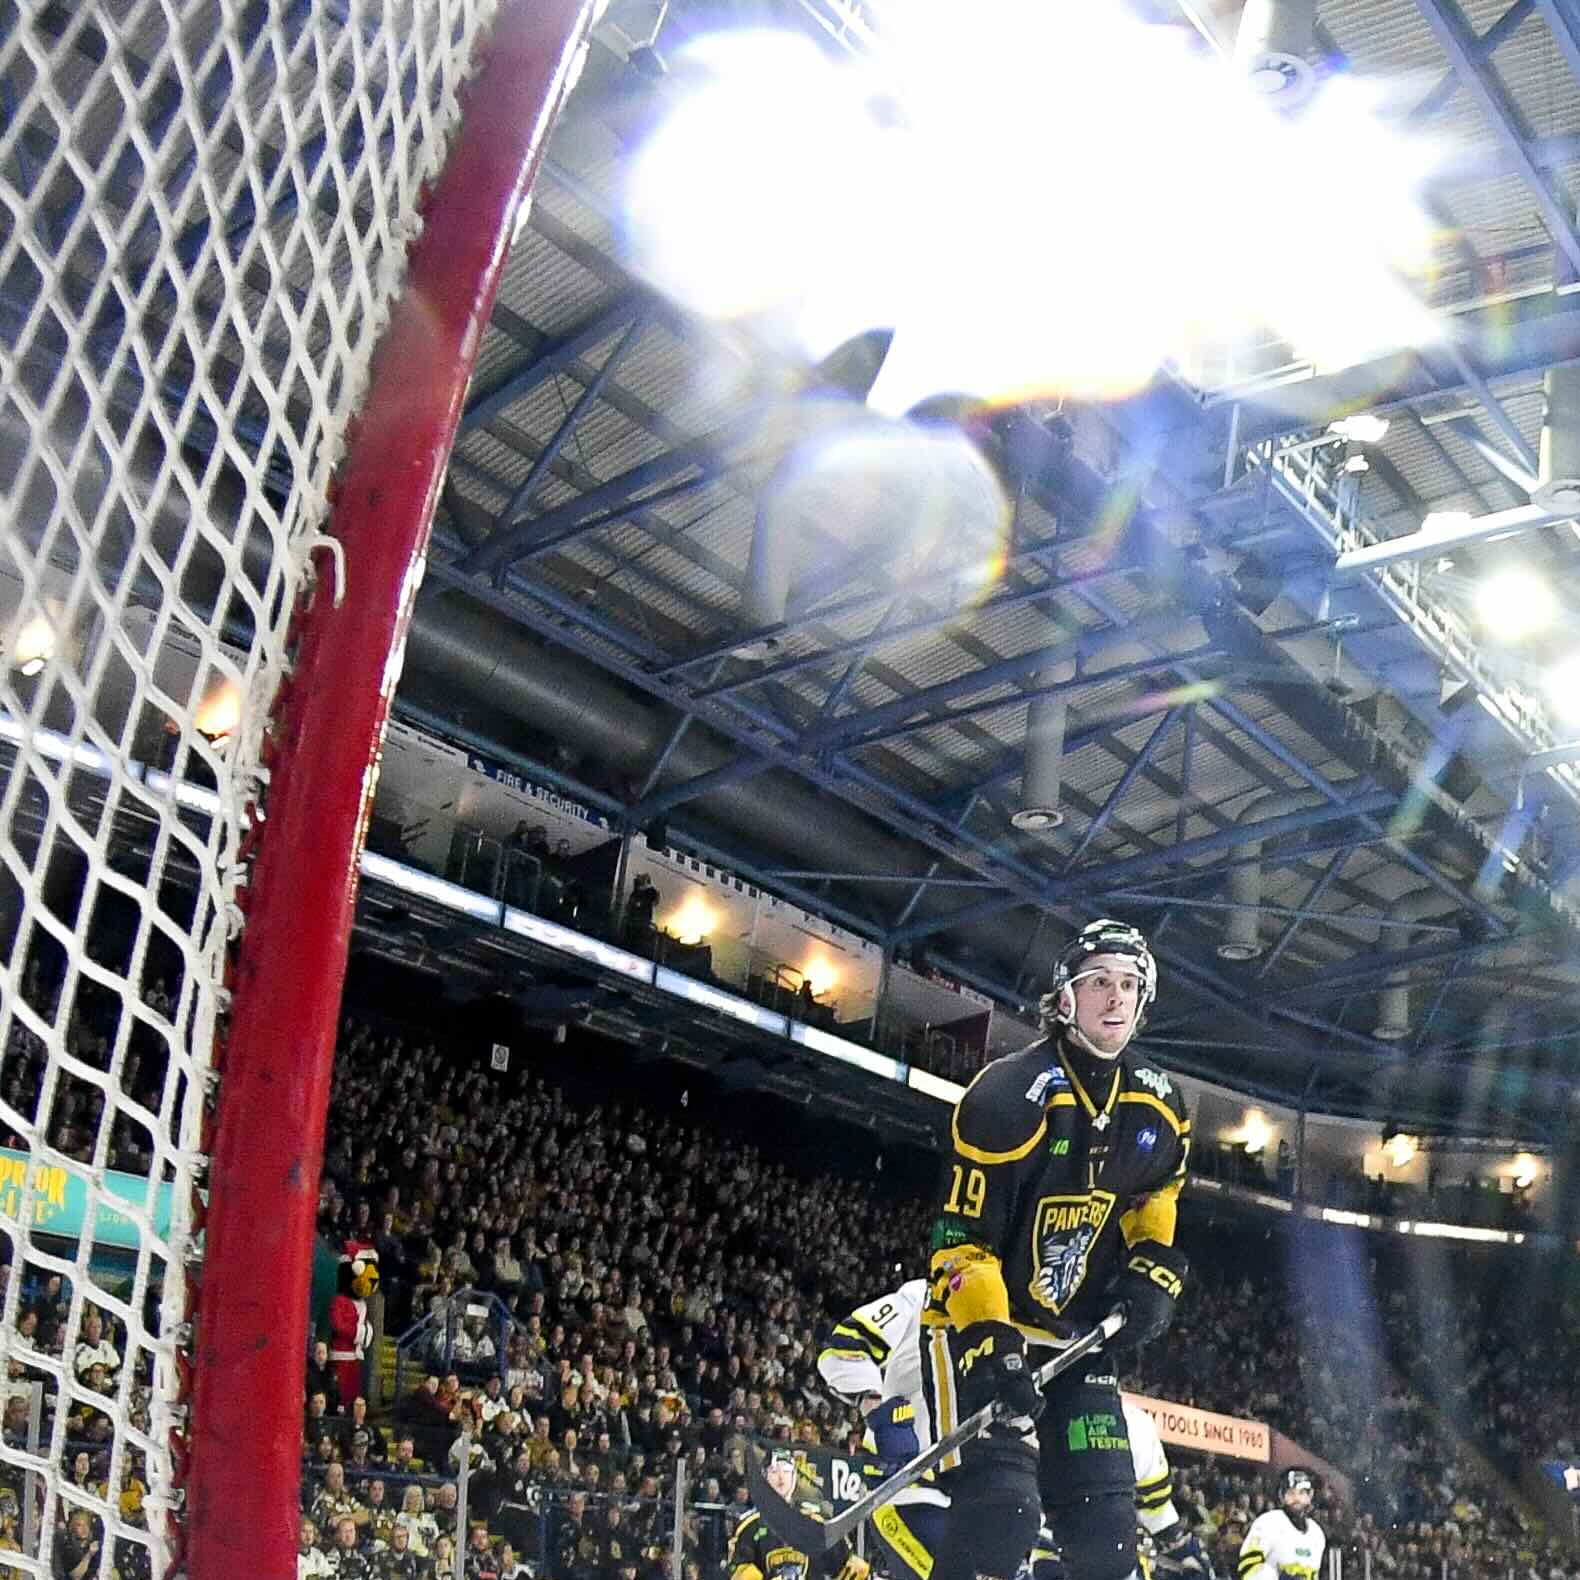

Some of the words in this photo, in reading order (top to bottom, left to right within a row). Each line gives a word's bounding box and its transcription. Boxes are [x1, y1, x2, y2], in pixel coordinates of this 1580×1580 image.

[944, 1164, 986, 1218] 19
[1162, 1412, 1200, 1437] TOOLS
[1204, 1421, 1234, 1444] SINCE
